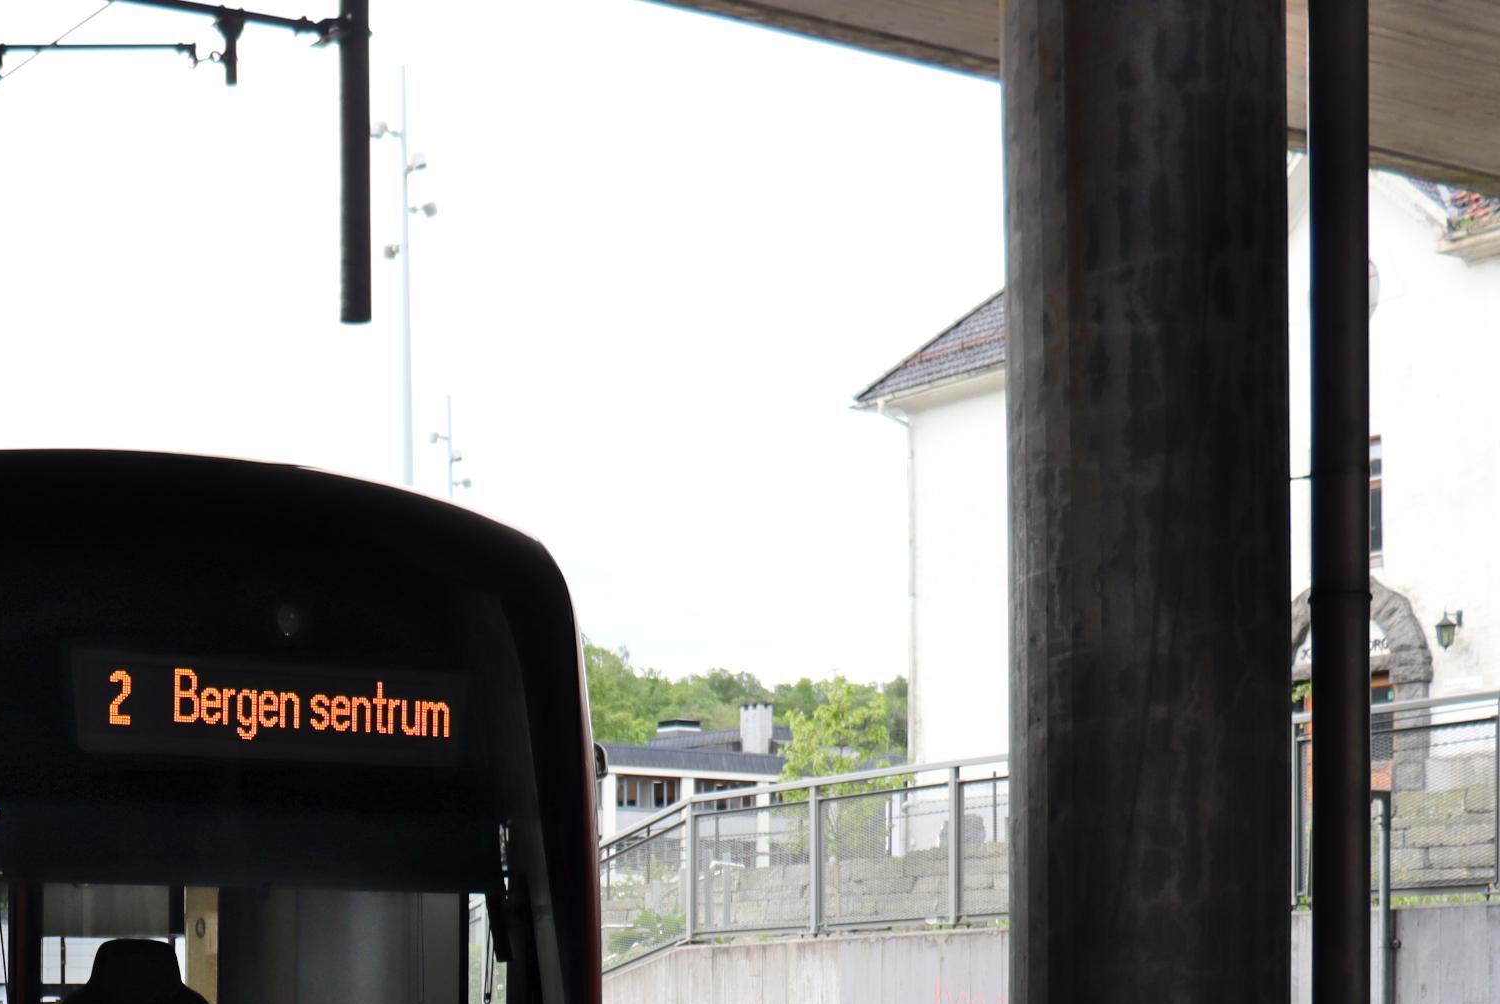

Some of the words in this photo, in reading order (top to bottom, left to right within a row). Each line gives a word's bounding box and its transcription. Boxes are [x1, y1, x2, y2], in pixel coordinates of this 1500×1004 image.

[108, 670, 132, 725] 2
[173, 667, 300, 740] Bergen
[310, 681, 451, 738] sentrum
